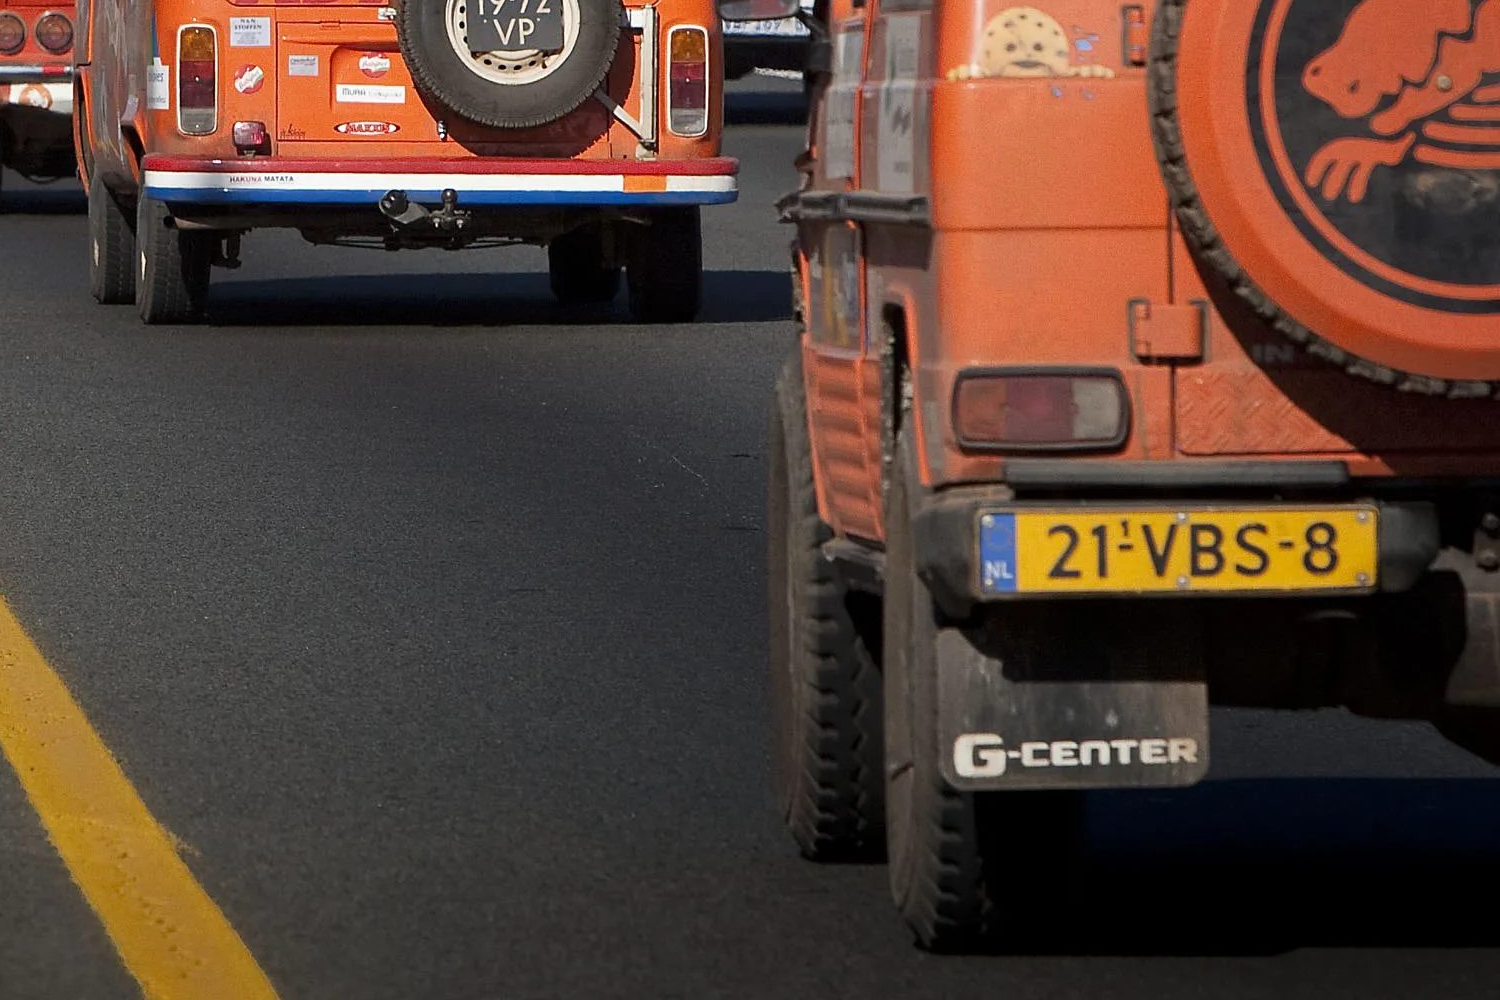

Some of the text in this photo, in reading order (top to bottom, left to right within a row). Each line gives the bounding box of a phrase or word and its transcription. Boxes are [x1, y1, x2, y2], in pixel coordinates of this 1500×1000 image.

[493, 18, 535, 46] VP
[984, 561, 1014, 580] NL
[953, 733, 1199, 778] G-CENTER
